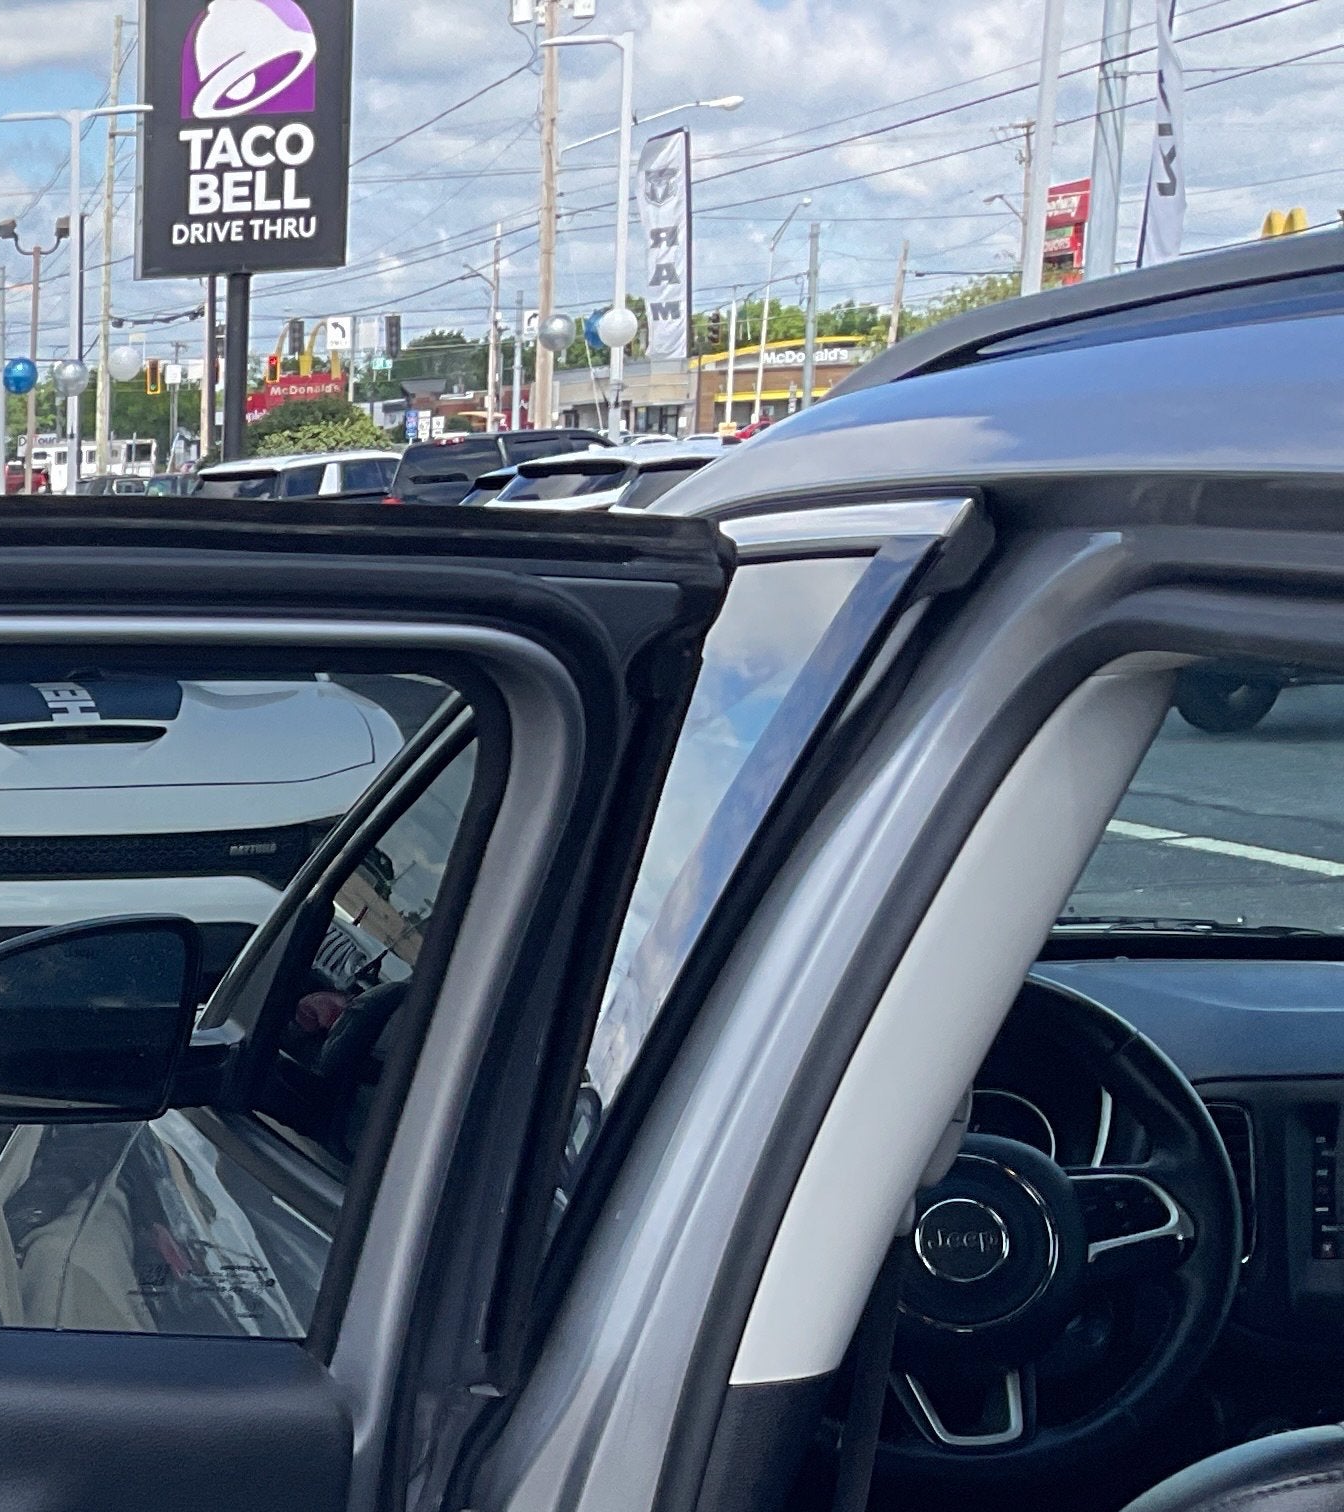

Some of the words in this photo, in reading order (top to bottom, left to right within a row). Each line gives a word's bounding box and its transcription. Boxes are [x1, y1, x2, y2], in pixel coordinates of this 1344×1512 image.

[179, 123, 315, 171] TACO
[188, 169, 311, 216] BELL
[172, 220, 244, 246] DRIVE
[250, 217, 317, 240] THRU
[763, 348, 849, 364] McDoald's
